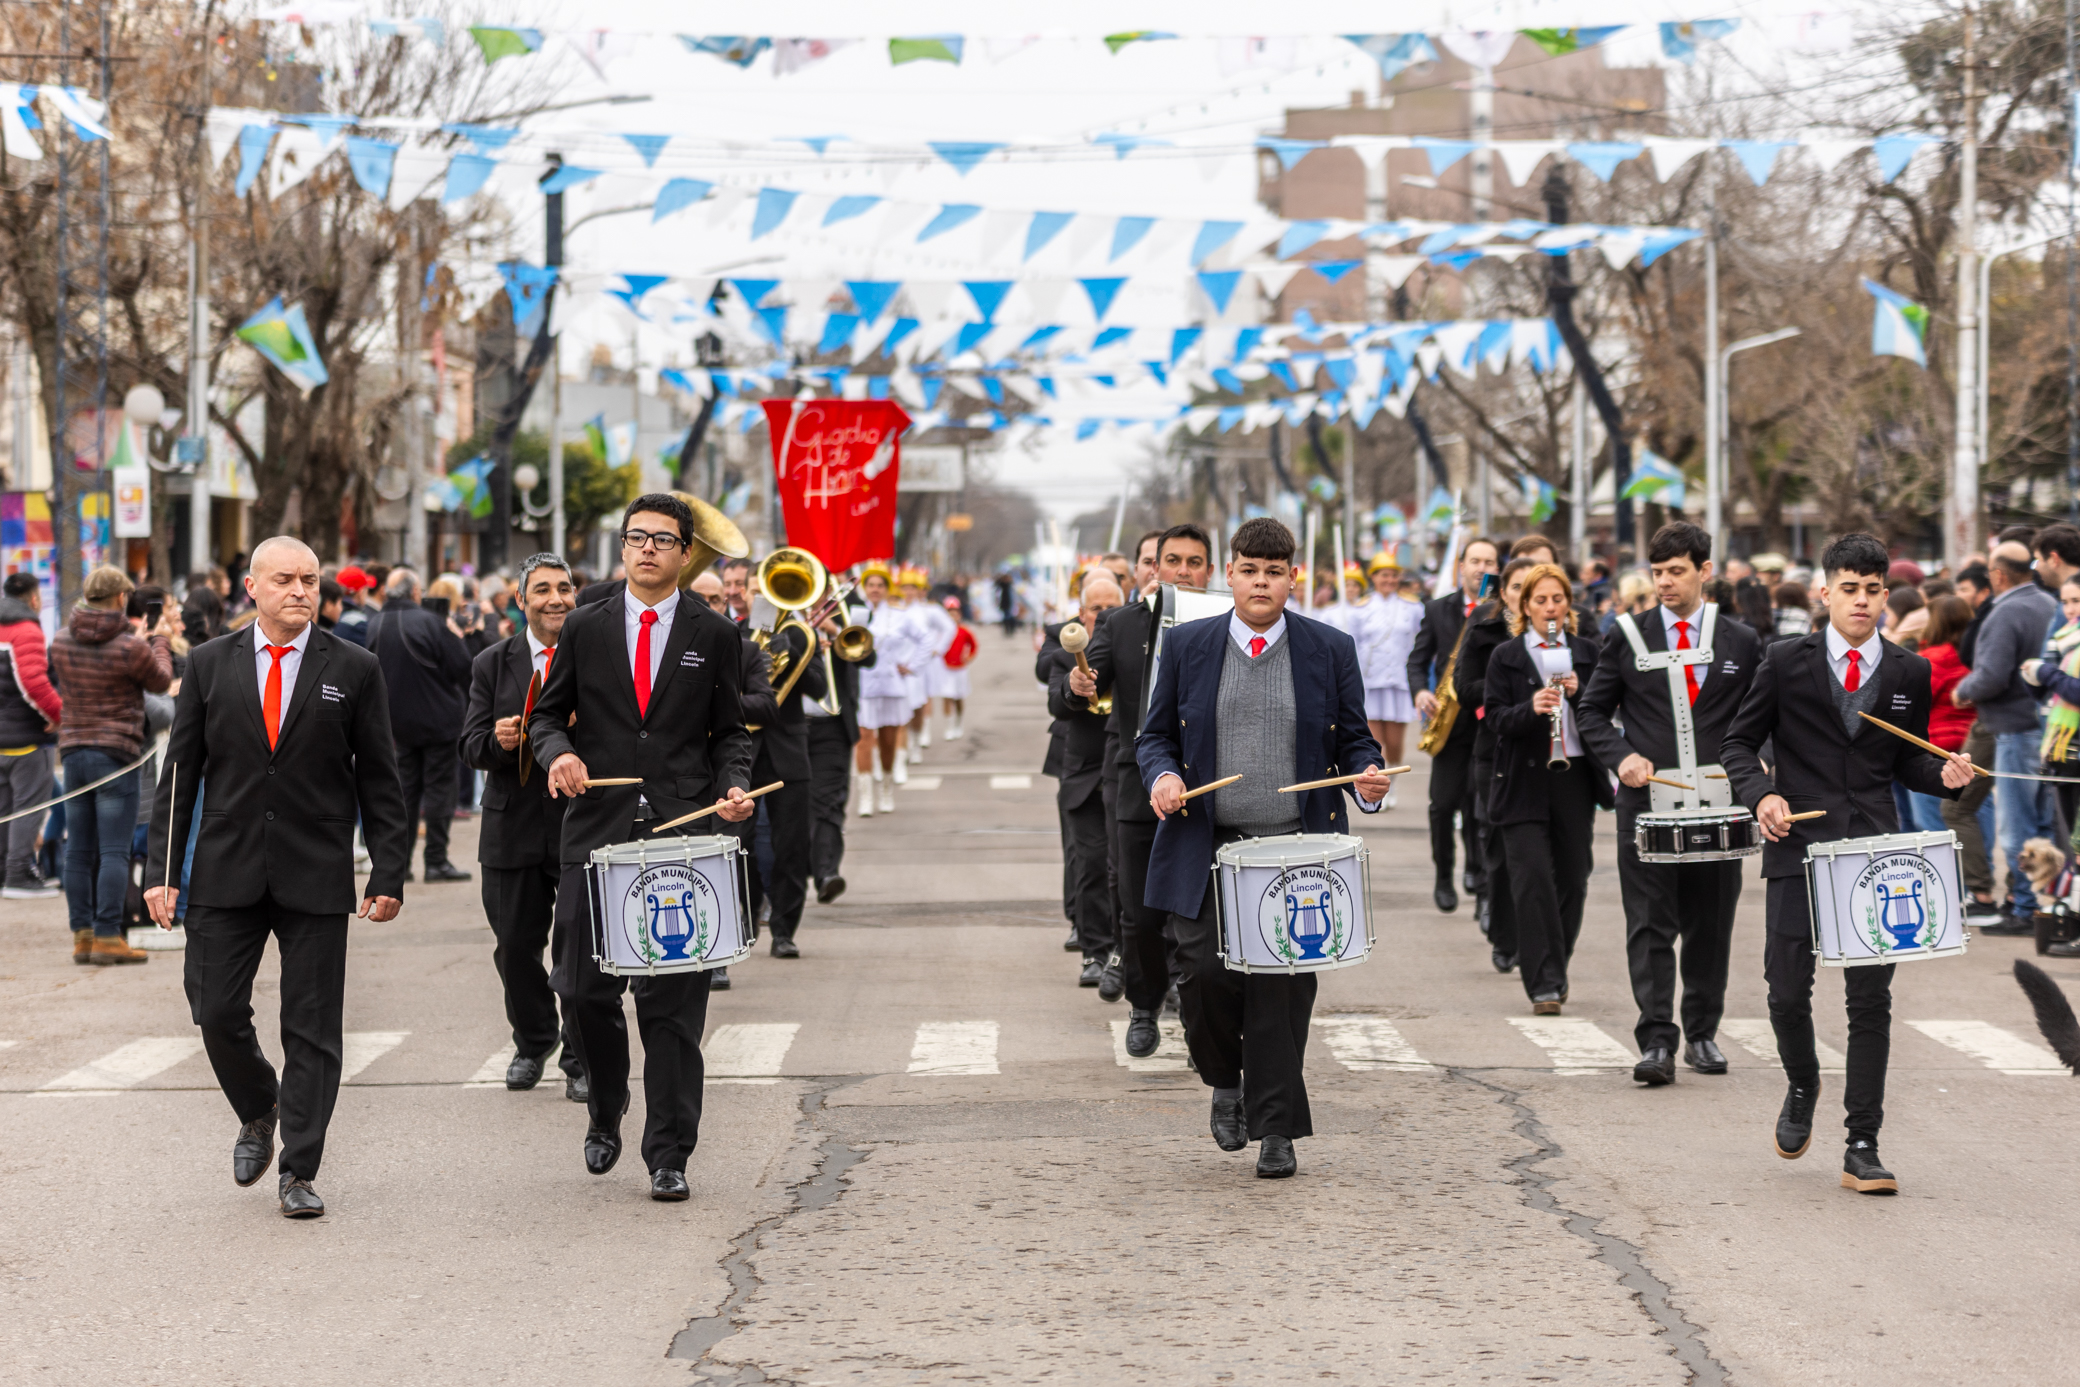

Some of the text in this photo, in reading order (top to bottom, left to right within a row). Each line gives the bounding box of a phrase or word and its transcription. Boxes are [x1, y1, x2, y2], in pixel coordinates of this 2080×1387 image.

[631, 869, 710, 899] BANDA MUNICIPAL
[1268, 869, 1344, 899] BANDA MUNICIPAL
[1859, 863, 1888, 889] BANDA
[1881, 871, 1915, 882] Lincoln
[651, 882, 685, 893] Lincoln
[1290, 882, 1323, 893] Lincoln
